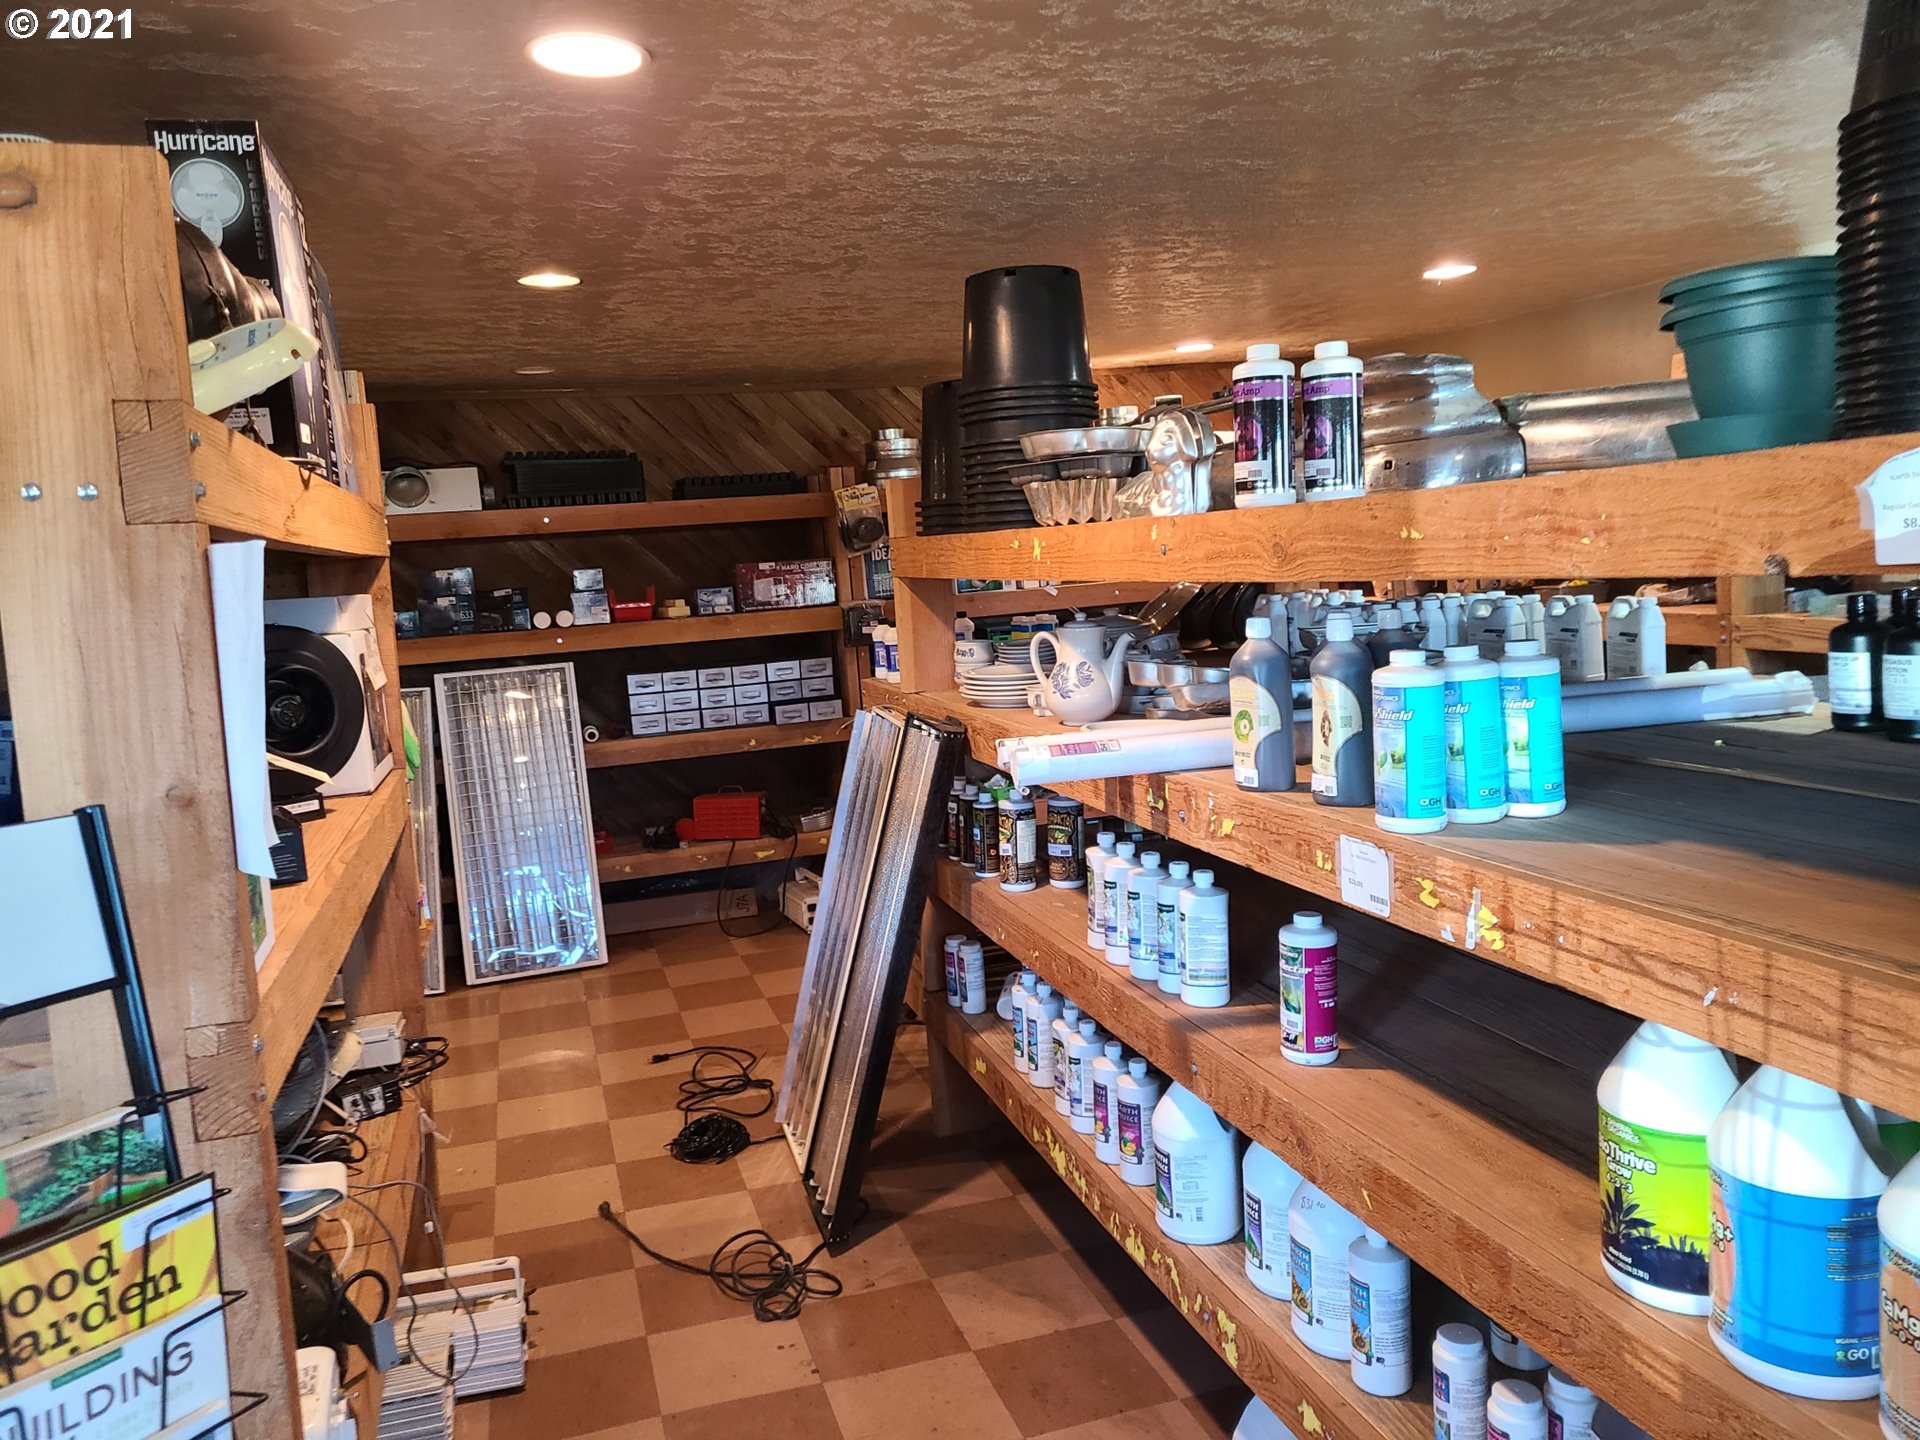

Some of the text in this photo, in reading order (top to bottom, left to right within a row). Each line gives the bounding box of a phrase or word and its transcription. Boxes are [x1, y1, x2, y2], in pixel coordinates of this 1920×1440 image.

[154, 129, 256, 155] Hurricane
[246, 158, 267, 261] SUPREME
[1375, 707, 1414, 721] Shield
[1599, 1136, 1657, 1175] oThrive
[1606, 1156, 1632, 1180] Grow
[6, 1240, 120, 1318] ood
[2, 1265, 182, 1368] arden
[1847, 1348, 1869, 1361] GO
[8, 1342, 193, 1440] UILDING
